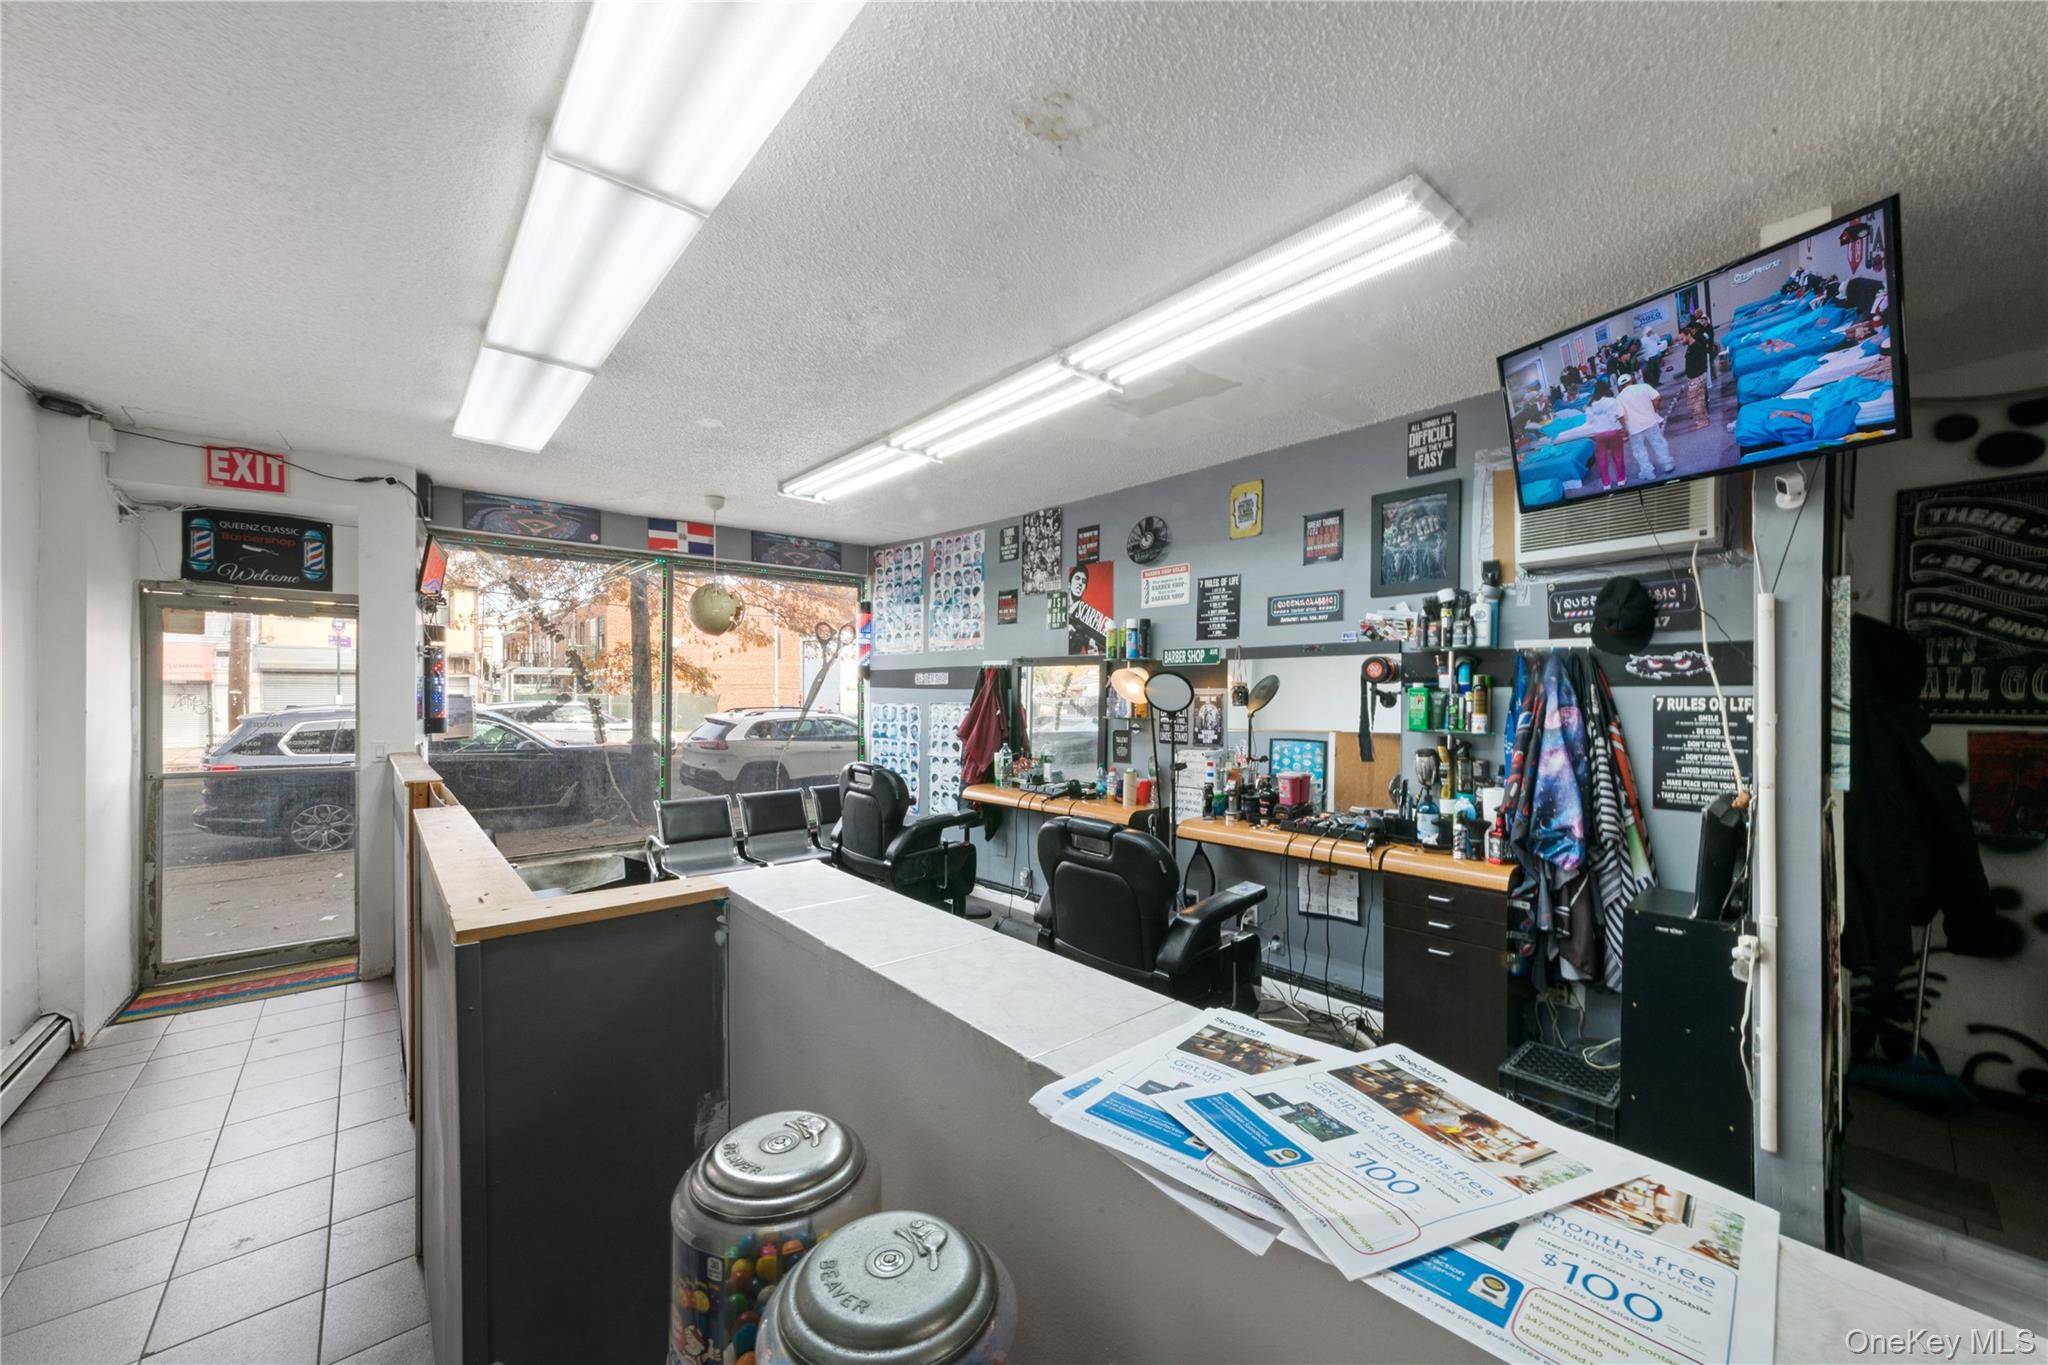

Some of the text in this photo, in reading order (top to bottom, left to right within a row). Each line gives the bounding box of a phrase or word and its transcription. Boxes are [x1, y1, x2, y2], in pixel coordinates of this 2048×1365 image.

[1411, 414, 1452, 432] ALL THINGS ARE
[1409, 423, 1455, 448] DIFFICULT
[1429, 442, 1442, 452] THEY
[1442, 440, 1454, 449] ARE
[210, 450, 285, 486] EXIT
[1418, 450, 1443, 470] EASY
[219, 520, 300, 536] QUEENZ CLASSIC
[1928, 506, 2027, 533] THERE
[220, 532, 297, 549] Barbershop
[216, 562, 300, 585] Welcome
[1945, 554, 1981, 572] BE
[1220, 577, 1228, 587] OF
[1228, 575, 1239, 586] LIFE
[1075, 600, 1108, 637] SCARFAC
[1915, 602, 1988, 624] EVERY
[1164, 650, 1186, 664] BARBER
[1187, 649, 1205, 663] SHOP
[1925, 636, 1977, 664] IT'S
[1919, 665, 1990, 701] ALL
[1656, 697, 1664, 711] 7
[1667, 697, 1707, 712] RULES
[1730, 697, 1753, 712] LIF
[1698, 714, 1719, 722] SMILE
[1705, 727, 1721, 736] KIND
[1687, 740, 1705, 748] DON'T
[1706, 741, 1721, 749] GIVE
[1685, 753, 1703, 761] DON'T
[1681, 766, 1735, 775] AVOID NEGATIVIT
[1660, 791, 1675, 799] TAKE
[1691, 793, 1699, 801] OF
[1683, 779, 1700, 787] PEACE
[1702, 780, 1719, 788] WITH
[1720, 781, 1736, 789] YOUR
[1214, 1016, 1266, 1037] Spectrum
[1173, 1058, 1223, 1082] Get up
[1395, 1054, 1448, 1084] Spectrum
[1312, 1081, 1337, 1098] Get
[1337, 1098, 1357, 1113] up
[1357, 1111, 1375, 1123] to
[1376, 1123, 1390, 1131] 4
[1388, 1131, 1451, 1170] months
[1453, 1170, 1494, 1197] free
[722, 1142, 763, 1176] BEAVER
[1349, 1149, 1421, 1194] $100
[1542, 1210, 1716, 1289] months free
[1562, 1226, 1633, 1264] business
[1638, 1260, 1714, 1298] services
[819, 1258, 870, 1315] BEAVER
[1537, 1235, 1711, 1316] Internet Phone TV Mobile
[1541, 1253, 1664, 1323] $100
[1399, 1281, 1416, 1294] get
[1456, 1313, 1485, 1331] price
[1485, 1327, 1539, 1361] guarantee
[1532, 1291, 1572, 1316] Please
[1573, 1311, 1595, 1326] feel
[1596, 1324, 1621, 1340] free
[1623, 1336, 1636, 1347] to
[1589, 1297, 1655, 1333] installation
[1528, 1302, 1630, 1358] Muhammad Khan
[1518, 1324, 1592, 1365] Muhammad
